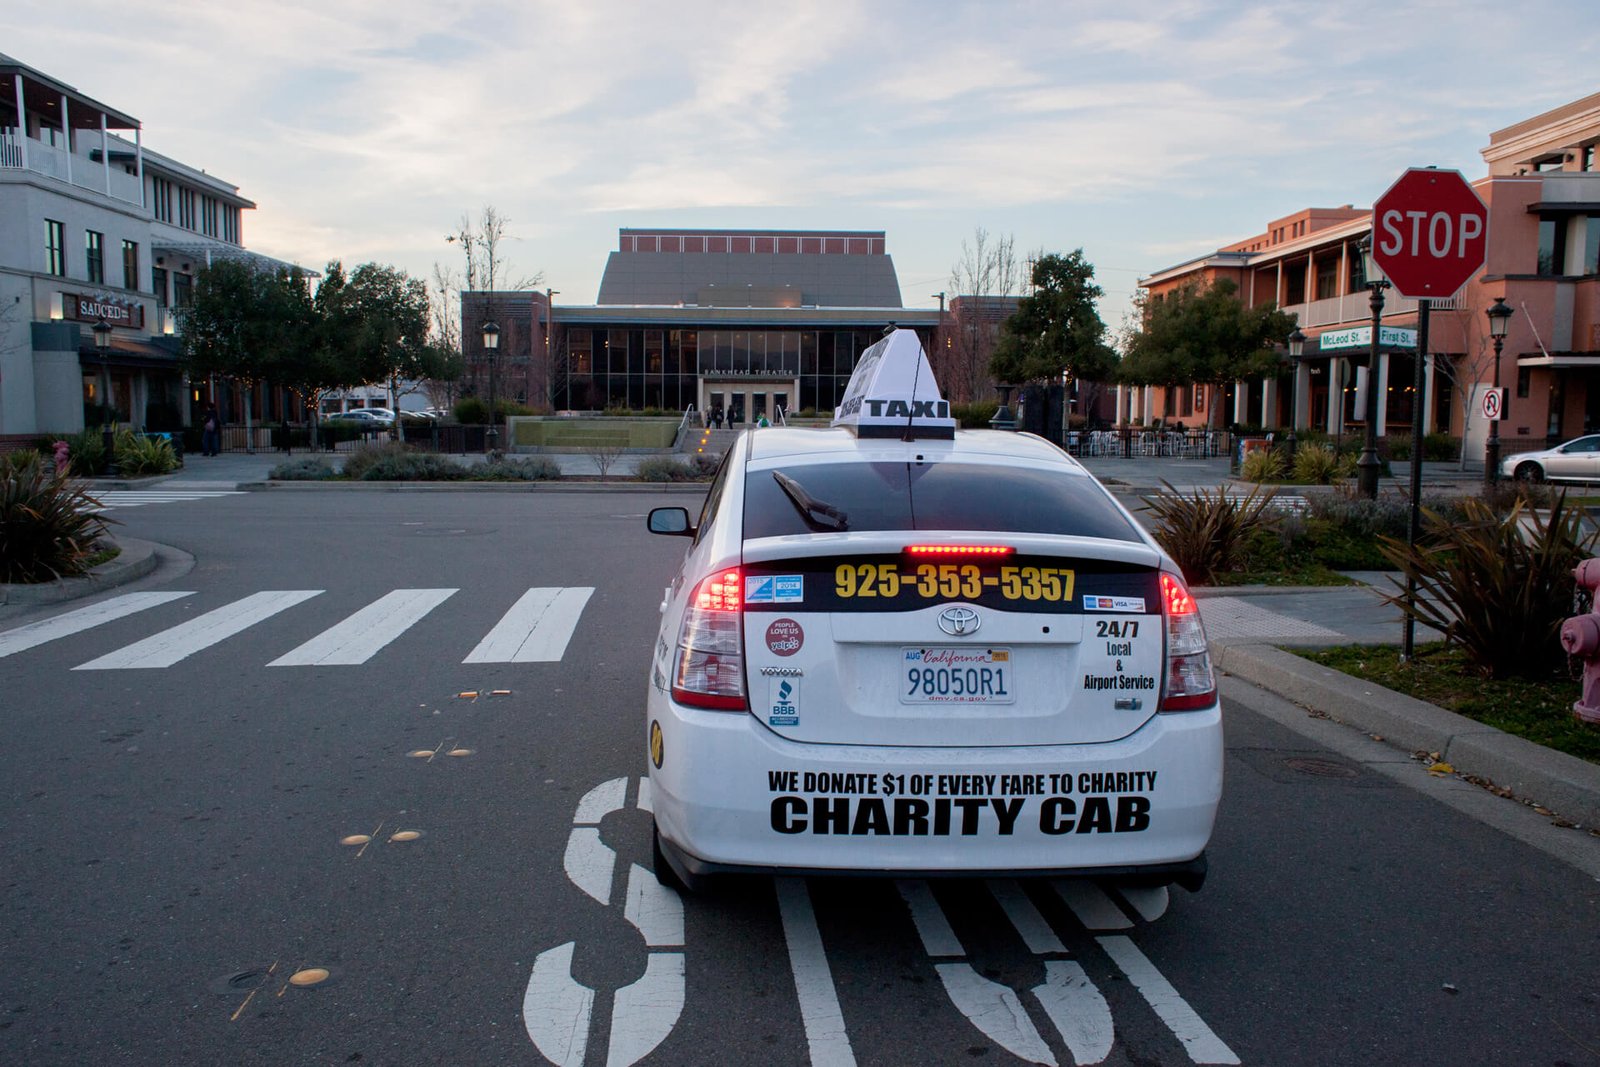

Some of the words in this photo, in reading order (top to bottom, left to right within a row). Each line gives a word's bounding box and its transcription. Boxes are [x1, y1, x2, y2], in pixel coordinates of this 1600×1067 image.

[1380, 209, 1483, 258] STOP
[80, 300, 121, 320] SAUCED
[1323, 333, 1349, 345] McLeod
[1350, 332, 1360, 342] St.
[1381, 330, 1399, 342] First
[1400, 332, 1410, 343] St.
[865, 399, 948, 418] TAXI
[835, 564, 1075, 602] 925-353-5357
[1096, 620, 1139, 638] 24/7
[771, 640, 792, 650] yelp
[1106, 641, 1131, 656] Local
[905, 651, 921, 660] AUG
[923, 649, 992, 667] California
[760, 667, 804, 677] TOYOTA
[1116, 659, 1123, 672] &
[908, 668, 1008, 696] 98050R1
[1084, 675, 1117, 691] Airport
[1119, 675, 1155, 690] Service
[773, 706, 796, 715] BBB
[768, 771, 799, 792] WE
[803, 772, 878, 794] DONATE
[882, 772, 905, 796] $1
[910, 774, 934, 795] OF
[938, 774, 997, 795] EVERY
[1000, 774, 1045, 795] FARE
[1049, 773, 1073, 794] TO
[1077, 771, 1157, 793] CHARITY
[770, 796, 1026, 836] CHARITY
[1039, 796, 1151, 836] CAB
